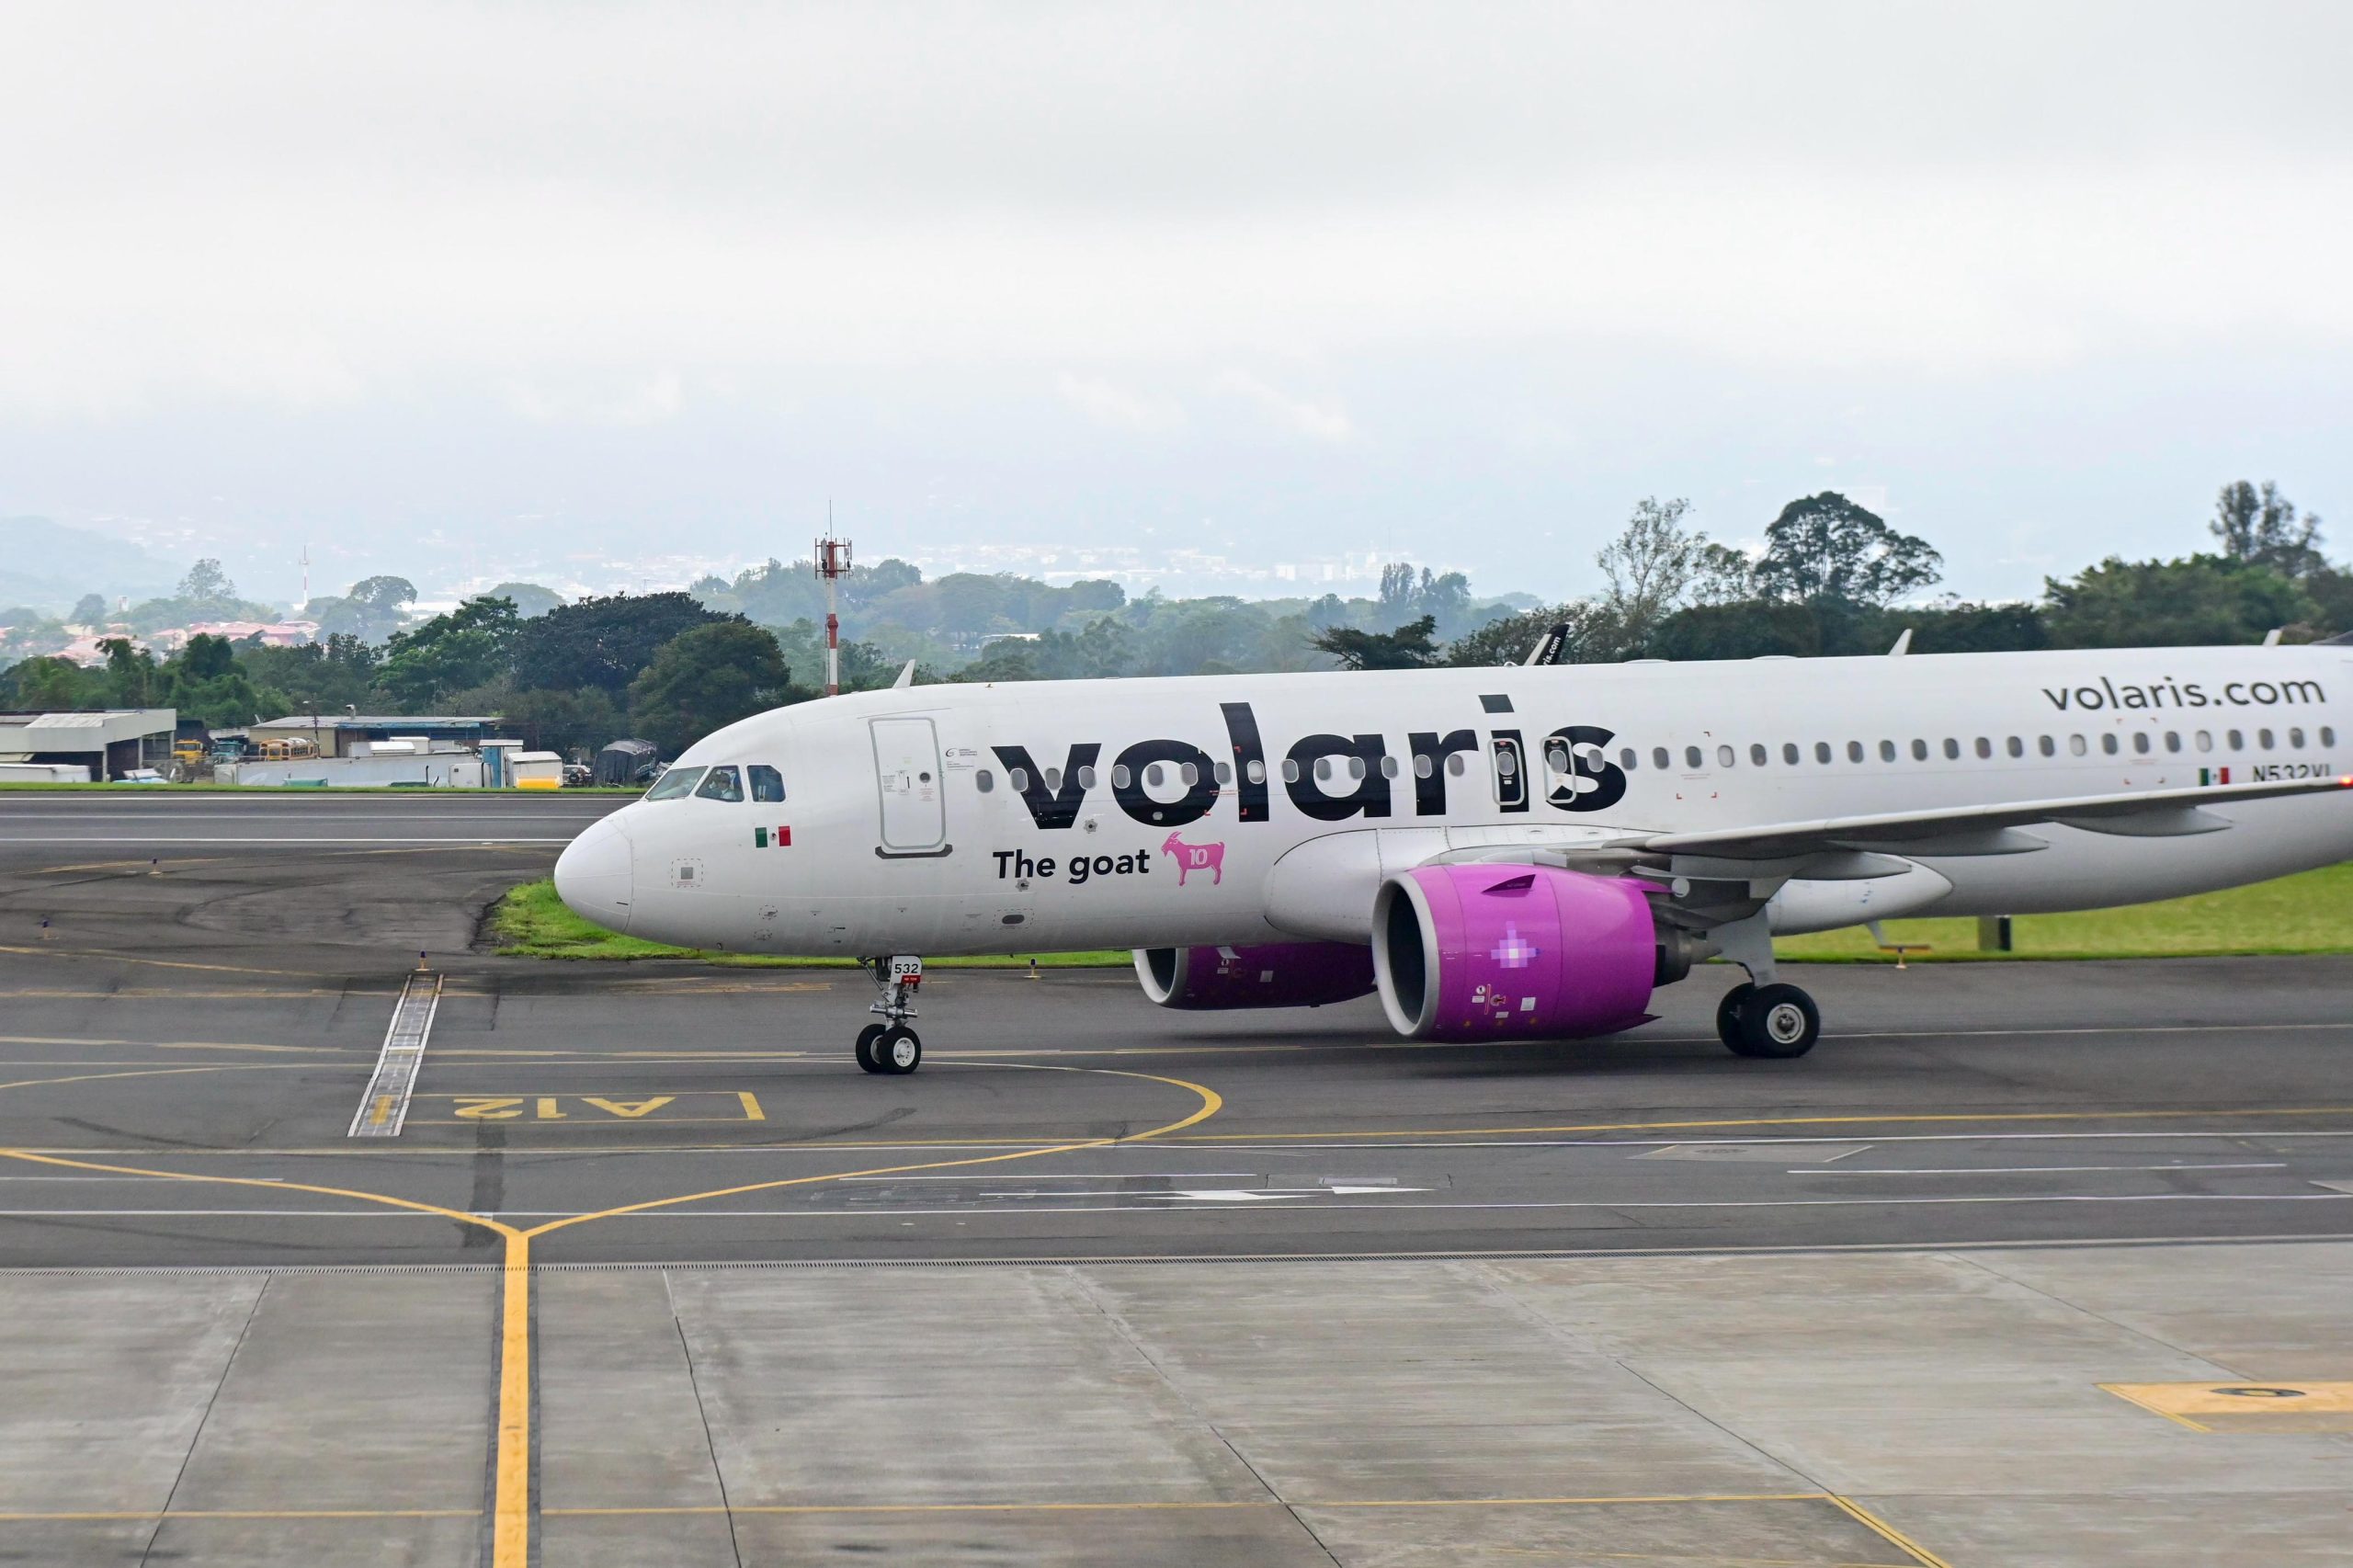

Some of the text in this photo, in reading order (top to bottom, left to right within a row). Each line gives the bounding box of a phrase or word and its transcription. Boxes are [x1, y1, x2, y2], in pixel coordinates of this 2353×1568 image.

[2041, 676, 2326, 711] volaris.com
[991, 694, 1627, 830] volaris
[992, 848, 1151, 885] The goat
[1189, 848, 1208, 866] 10
[894, 963, 919, 974] 532
[453, 1096, 676, 1119] A12
